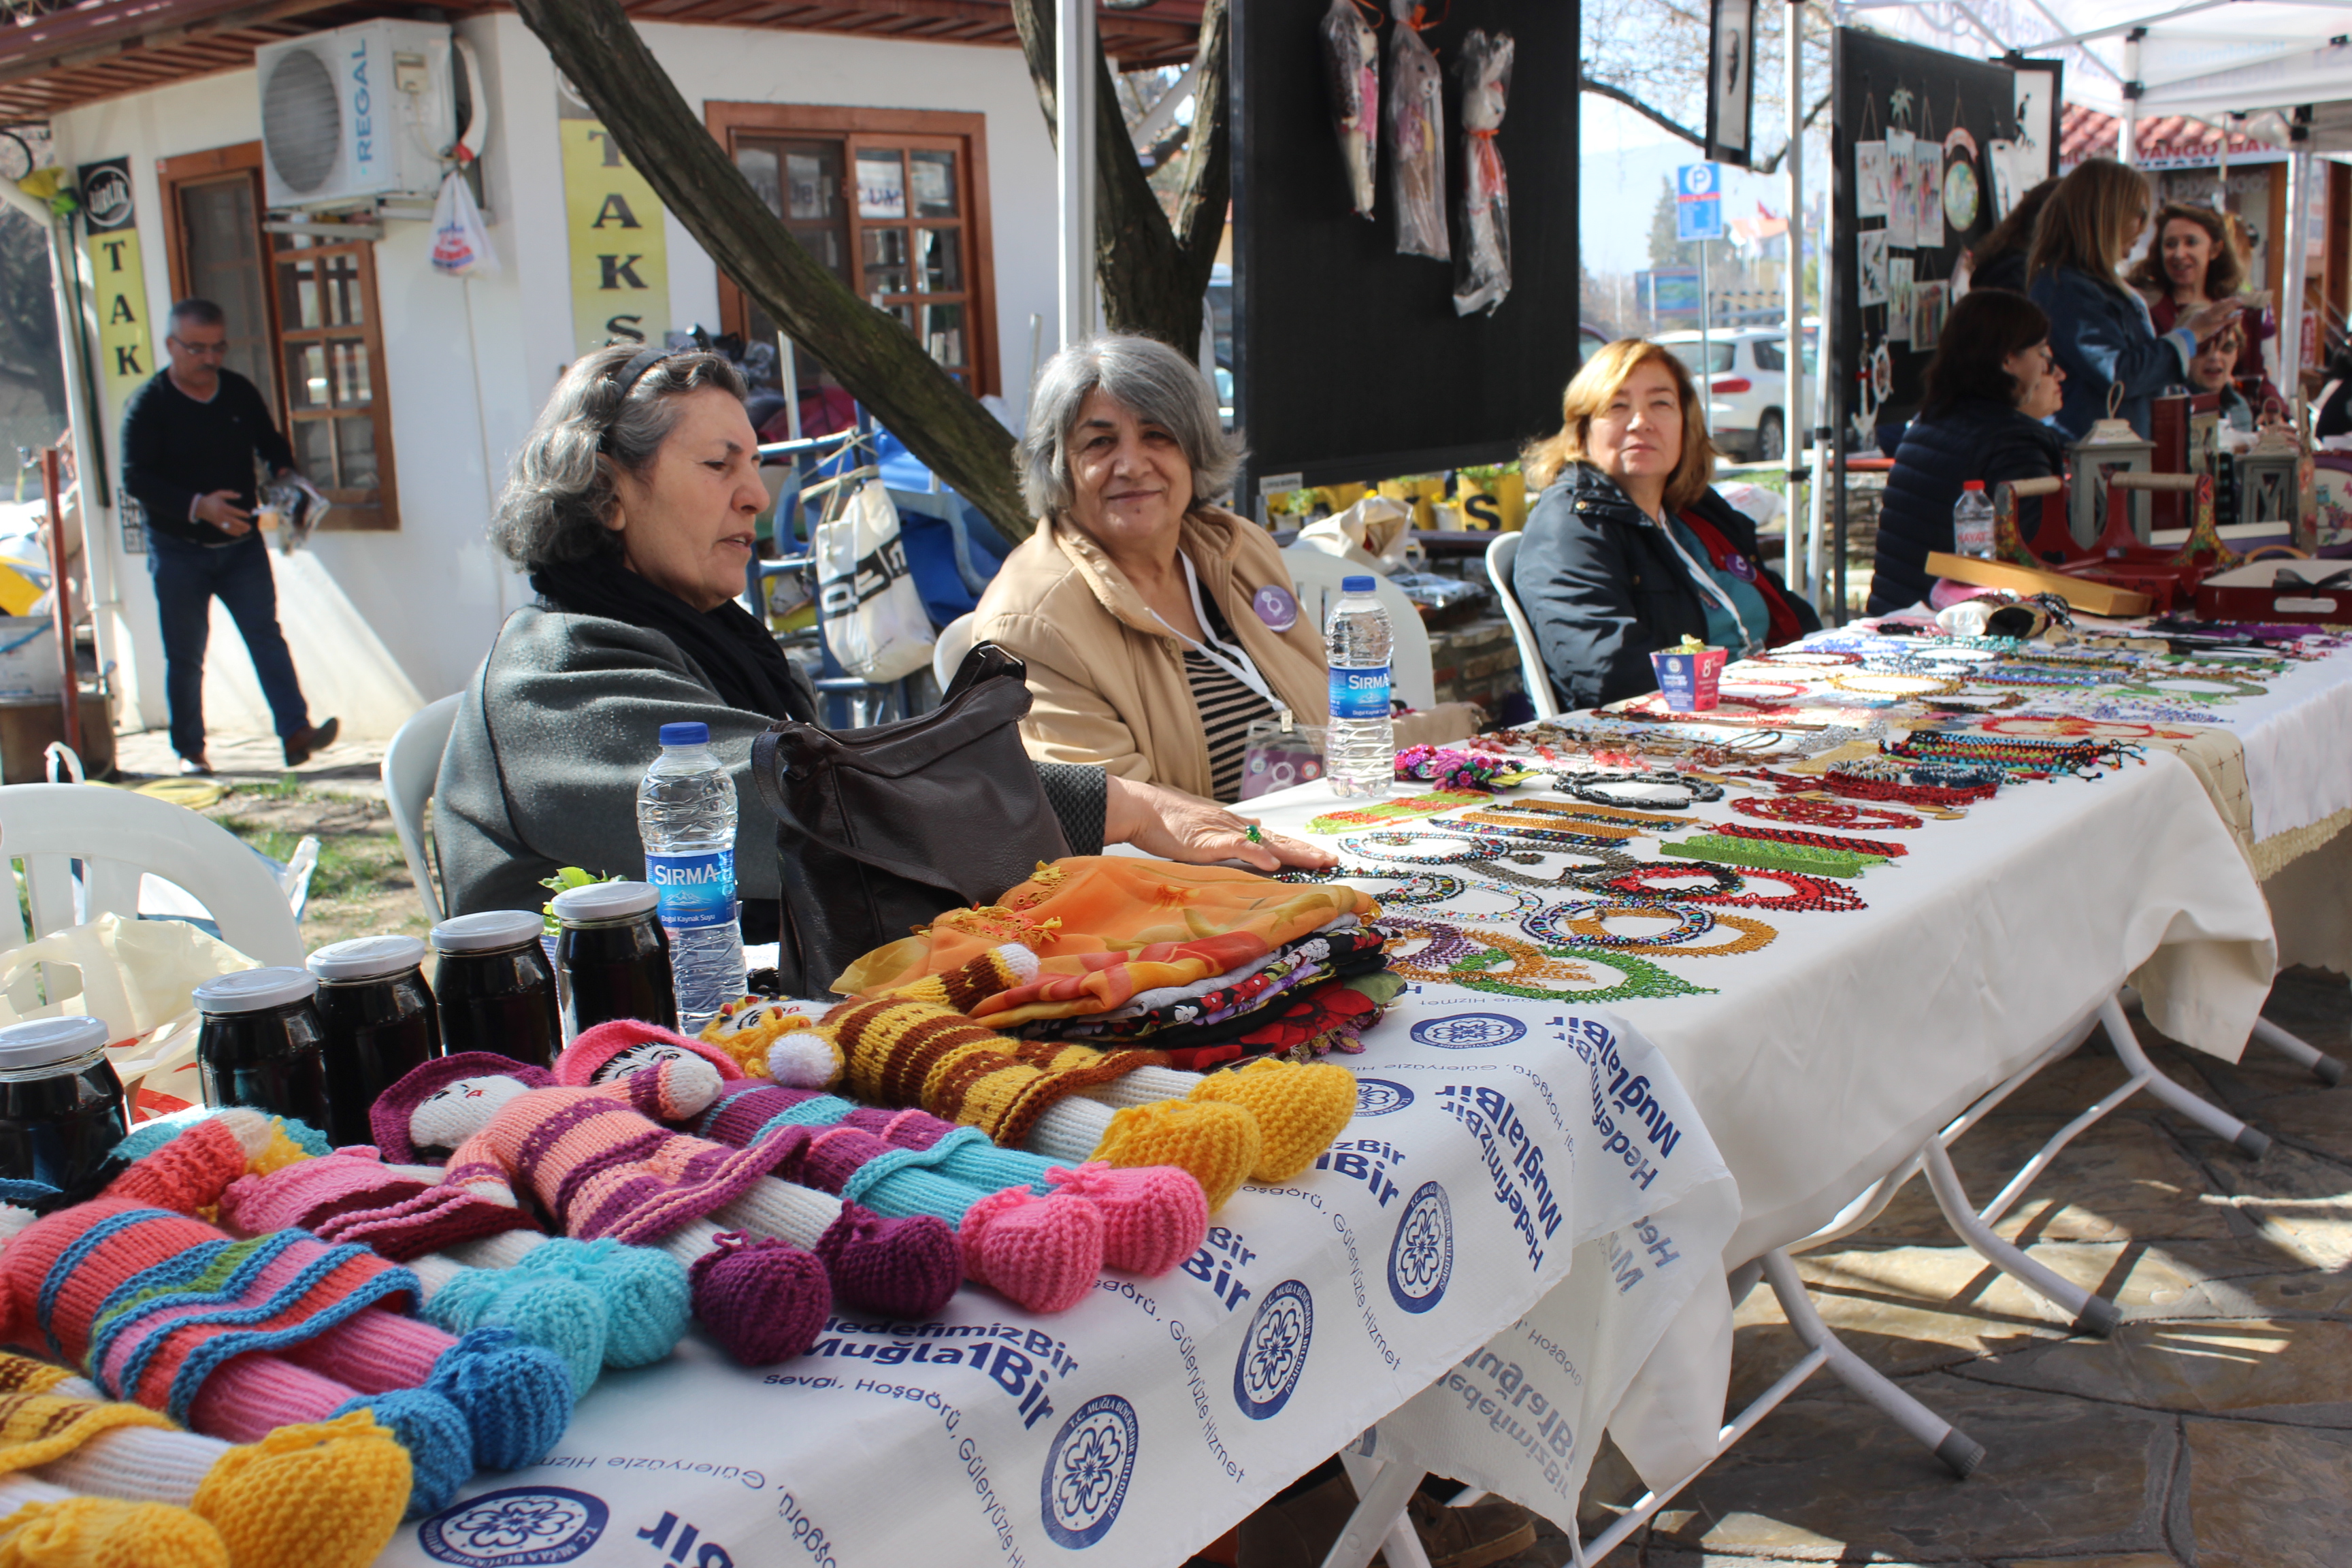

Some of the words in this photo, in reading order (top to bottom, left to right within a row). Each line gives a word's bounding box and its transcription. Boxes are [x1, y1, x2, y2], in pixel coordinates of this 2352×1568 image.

[351, 38, 373, 163] REGAL
[587, 129, 649, 346] TAKS
[102, 240, 144, 376] TAK
[1348, 672, 1389, 689] SIRMA
[654, 863, 719, 885] SIRMA
[676, 915, 700, 924] Kaynak
[1419, 997, 1486, 1006] Hizmet
[1240, 1186, 1327, 1215] oşgörü,
[1333, 1213, 1365, 1307] Güleryüzle
[1362, 1306, 1401, 1371] Hizmet
[1170, 1320, 1209, 1419] Güleryüzle
[1202, 1416, 1245, 1484] Hizmet
[606, 1455, 766, 1490] Güleryüzle
[855, 1379, 962, 1439] Hoşgörü,
[958, 1437, 1014, 1551] Güleryüzle
[777, 1484, 836, 1568] oşgörü,
